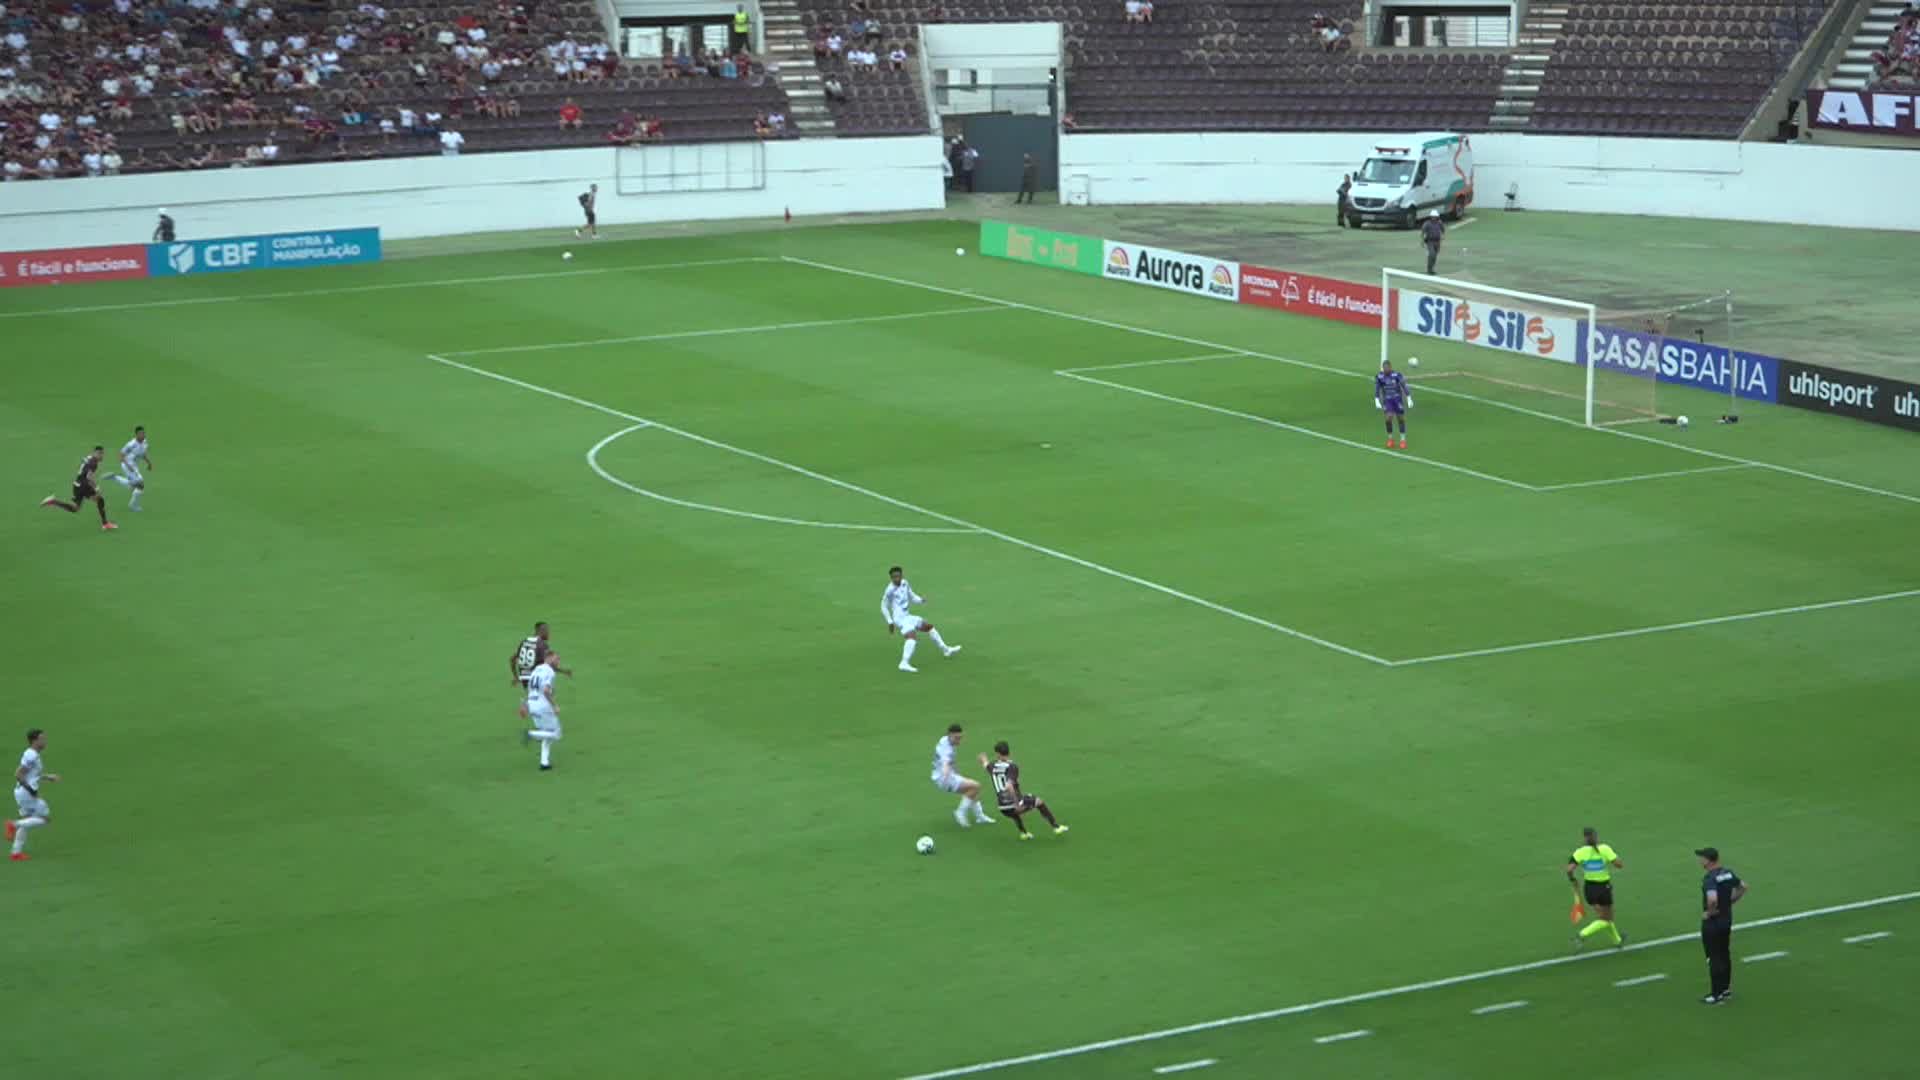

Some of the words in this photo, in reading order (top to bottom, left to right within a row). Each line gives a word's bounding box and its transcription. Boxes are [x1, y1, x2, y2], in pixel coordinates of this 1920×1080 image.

[1816, 91, 1920, 129] AF
[204, 242, 259, 267] CBF
[272, 236, 322, 249] CONTRA
[324, 235, 334, 244] A
[1136, 250, 1204, 289] Aurora
[1417, 296, 1453, 336] Sil
[1488, 308, 1525, 350] Sil
[1789, 371, 1874, 408] uhlsport
[518, 647, 536, 666] 99
[992, 773, 1007, 793] 10
